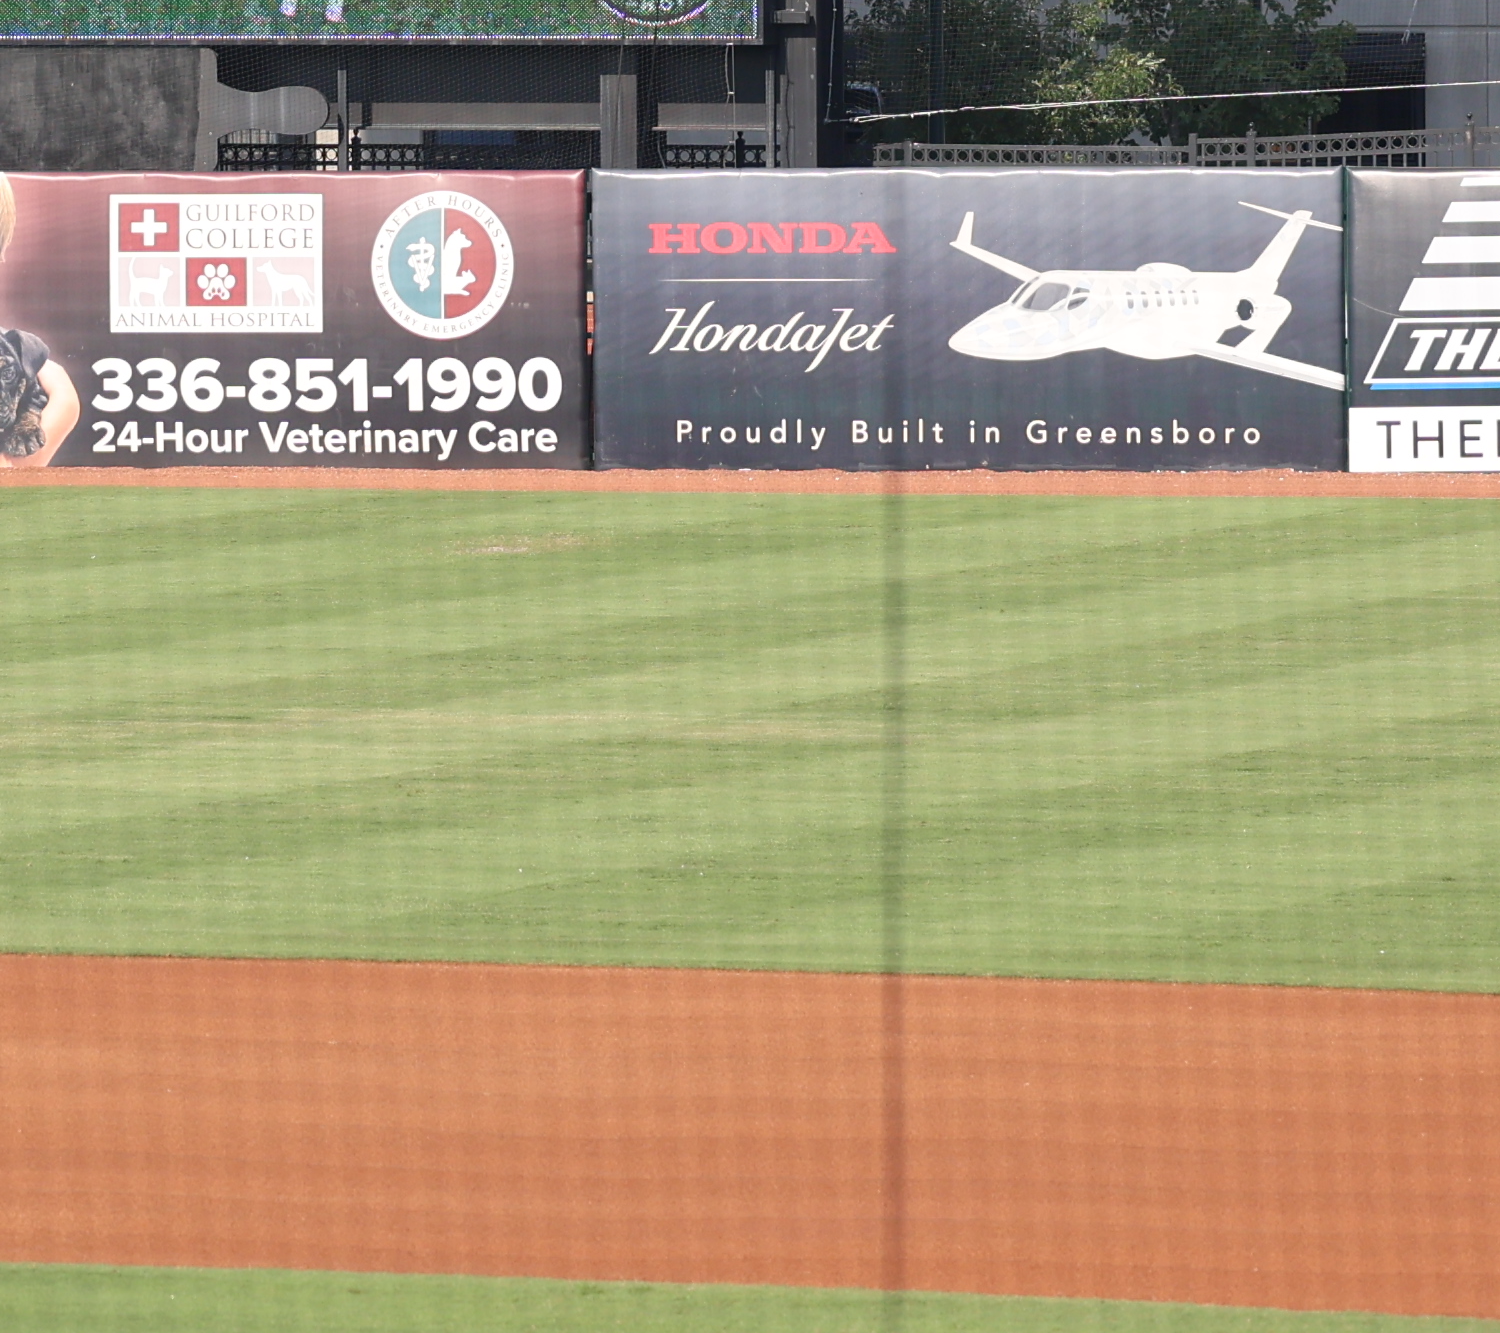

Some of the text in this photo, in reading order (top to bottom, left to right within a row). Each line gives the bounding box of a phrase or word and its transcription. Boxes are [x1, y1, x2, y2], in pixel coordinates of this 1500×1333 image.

[186, 203, 315, 222] GUILFORD
[385, 194, 502, 238] AFTER HOURS
[186, 228, 314, 249] COLLEGE
[648, 222, 897, 254] HONDA
[376, 253, 510, 333] VETERINARY EMERGENCY CLINIC
[115, 312, 315, 327] ANIMAL HOSPITAL
[92, 357, 563, 414] 336-851-1990
[92, 421, 558, 462] 24-Hour Veterinary Care
[676, 419, 1261, 450] Proudly Built in Greensboro
